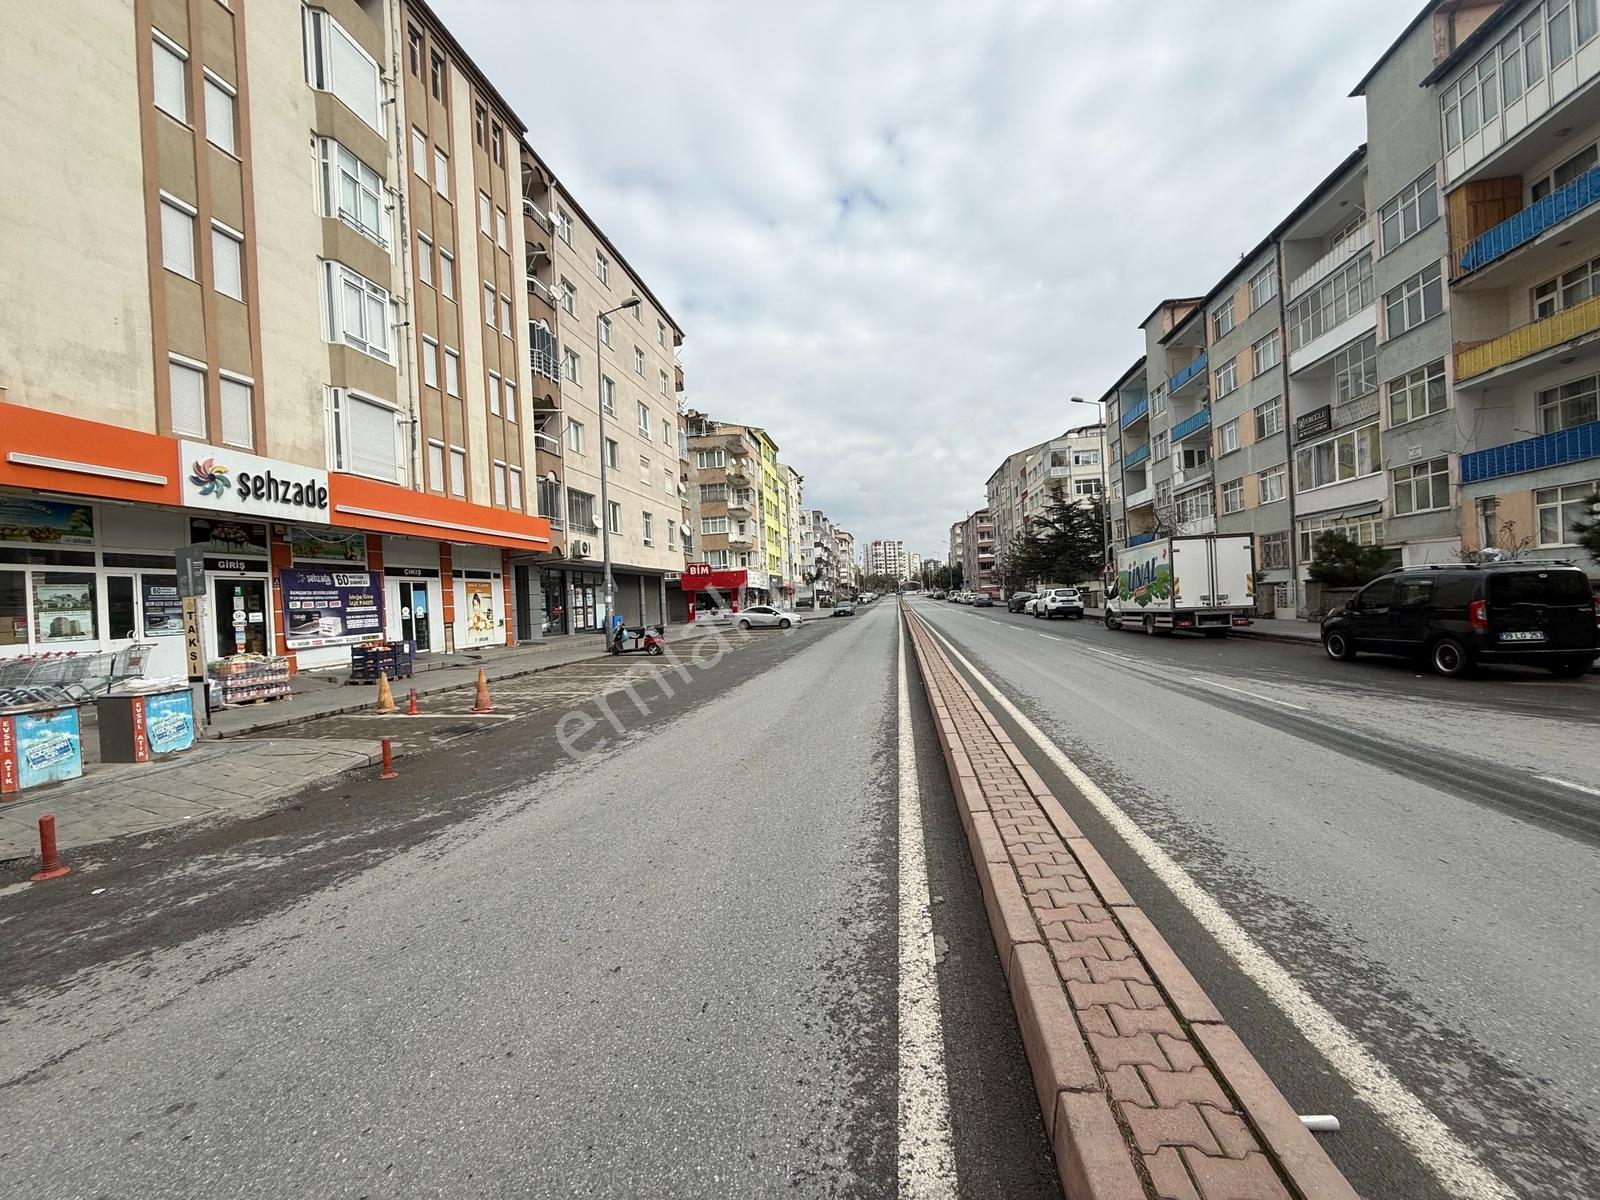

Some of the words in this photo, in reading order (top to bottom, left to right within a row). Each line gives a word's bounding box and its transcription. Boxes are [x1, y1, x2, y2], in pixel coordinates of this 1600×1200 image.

[237, 470, 327, 510] şehzade
[217, 560, 246, 571] GİRİŞ
[403, 568, 422, 576] ÇIKIŞ
[690, 565, 709, 575] BİM
[135, 702, 143, 730] EVSEL
[2, 721, 11, 753] EVSEL
[137, 735, 145, 757] ATIK
[4, 759, 13, 785] ATIK
